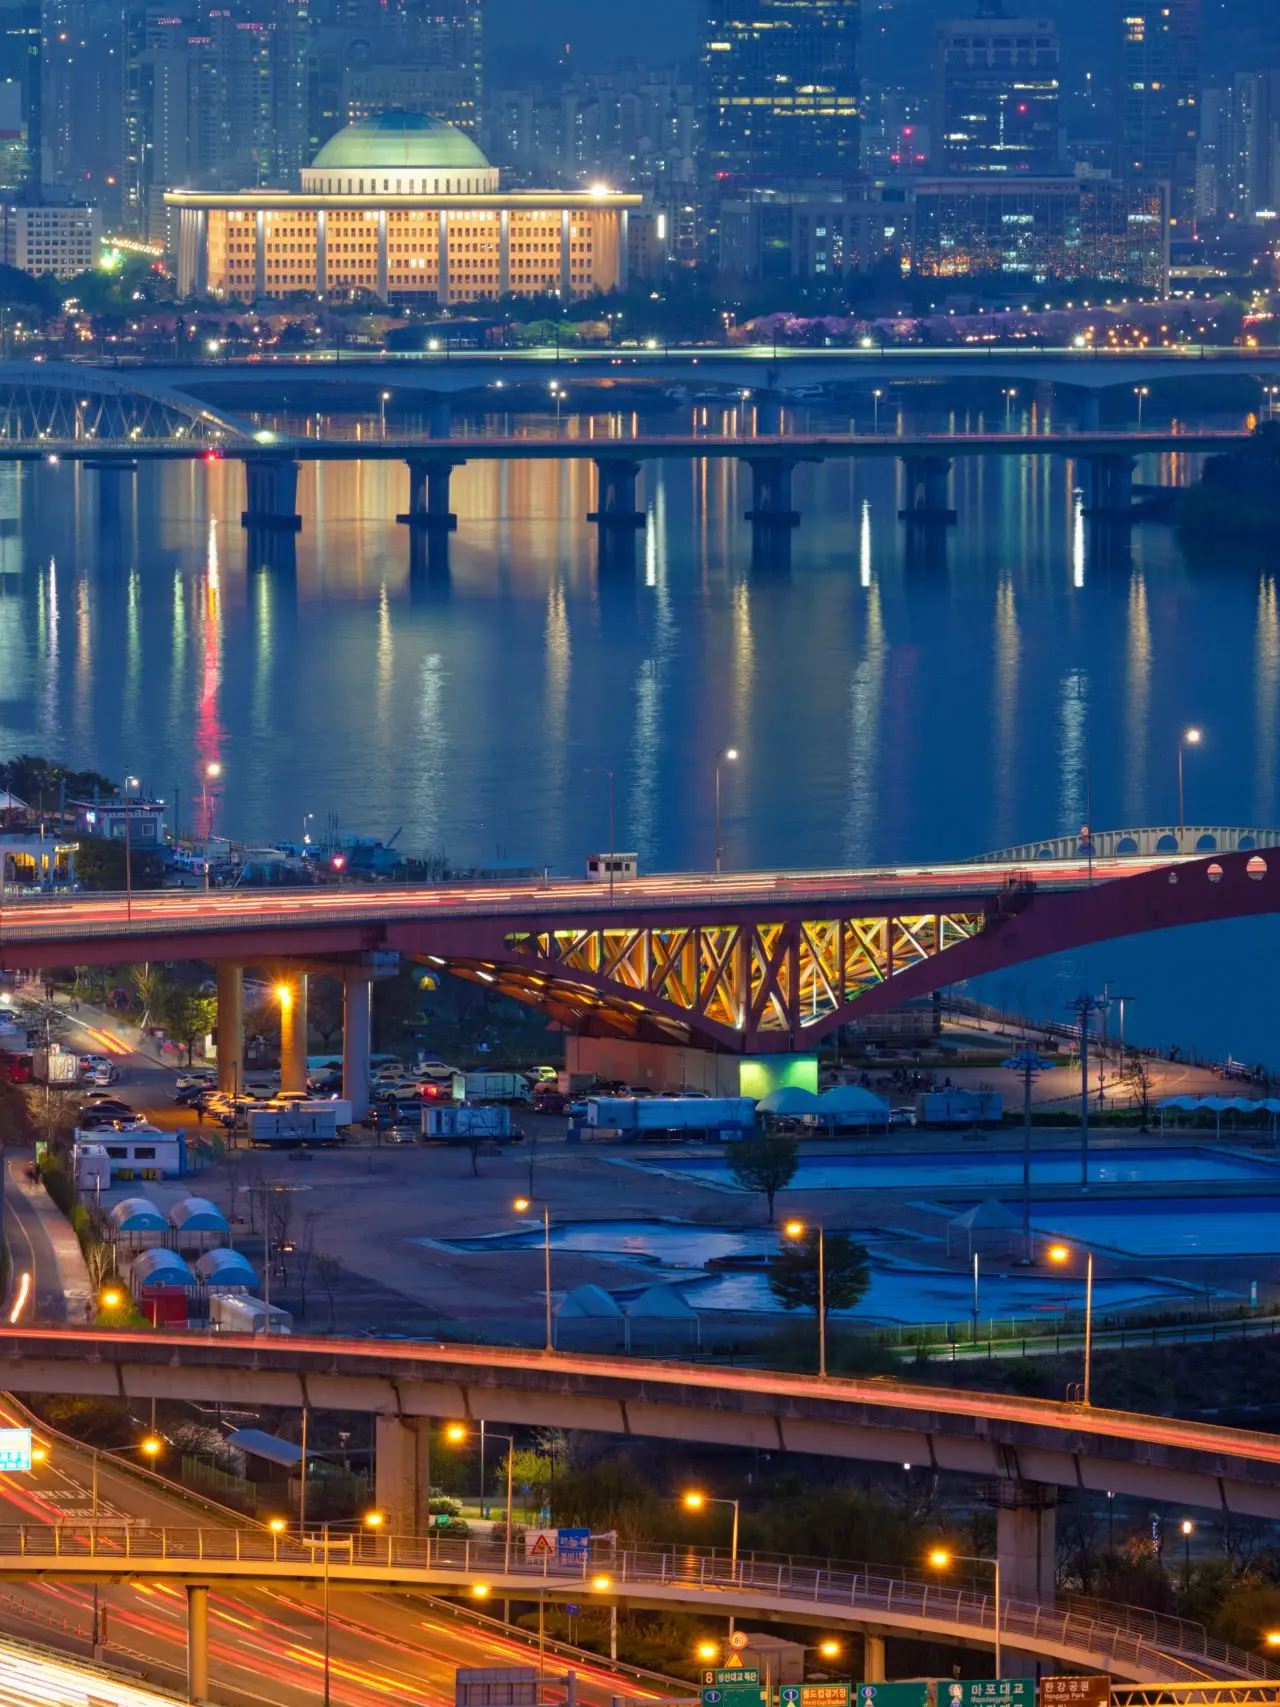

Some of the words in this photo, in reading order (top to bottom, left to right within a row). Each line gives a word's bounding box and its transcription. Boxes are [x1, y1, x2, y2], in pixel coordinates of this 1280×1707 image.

[705, 1671, 713, 1684] 8
[865, 1687, 872, 1697] 6
[971, 1683, 1024, 1696] 마포대교
[1045, 1680, 1089, 1693] 한강공원
